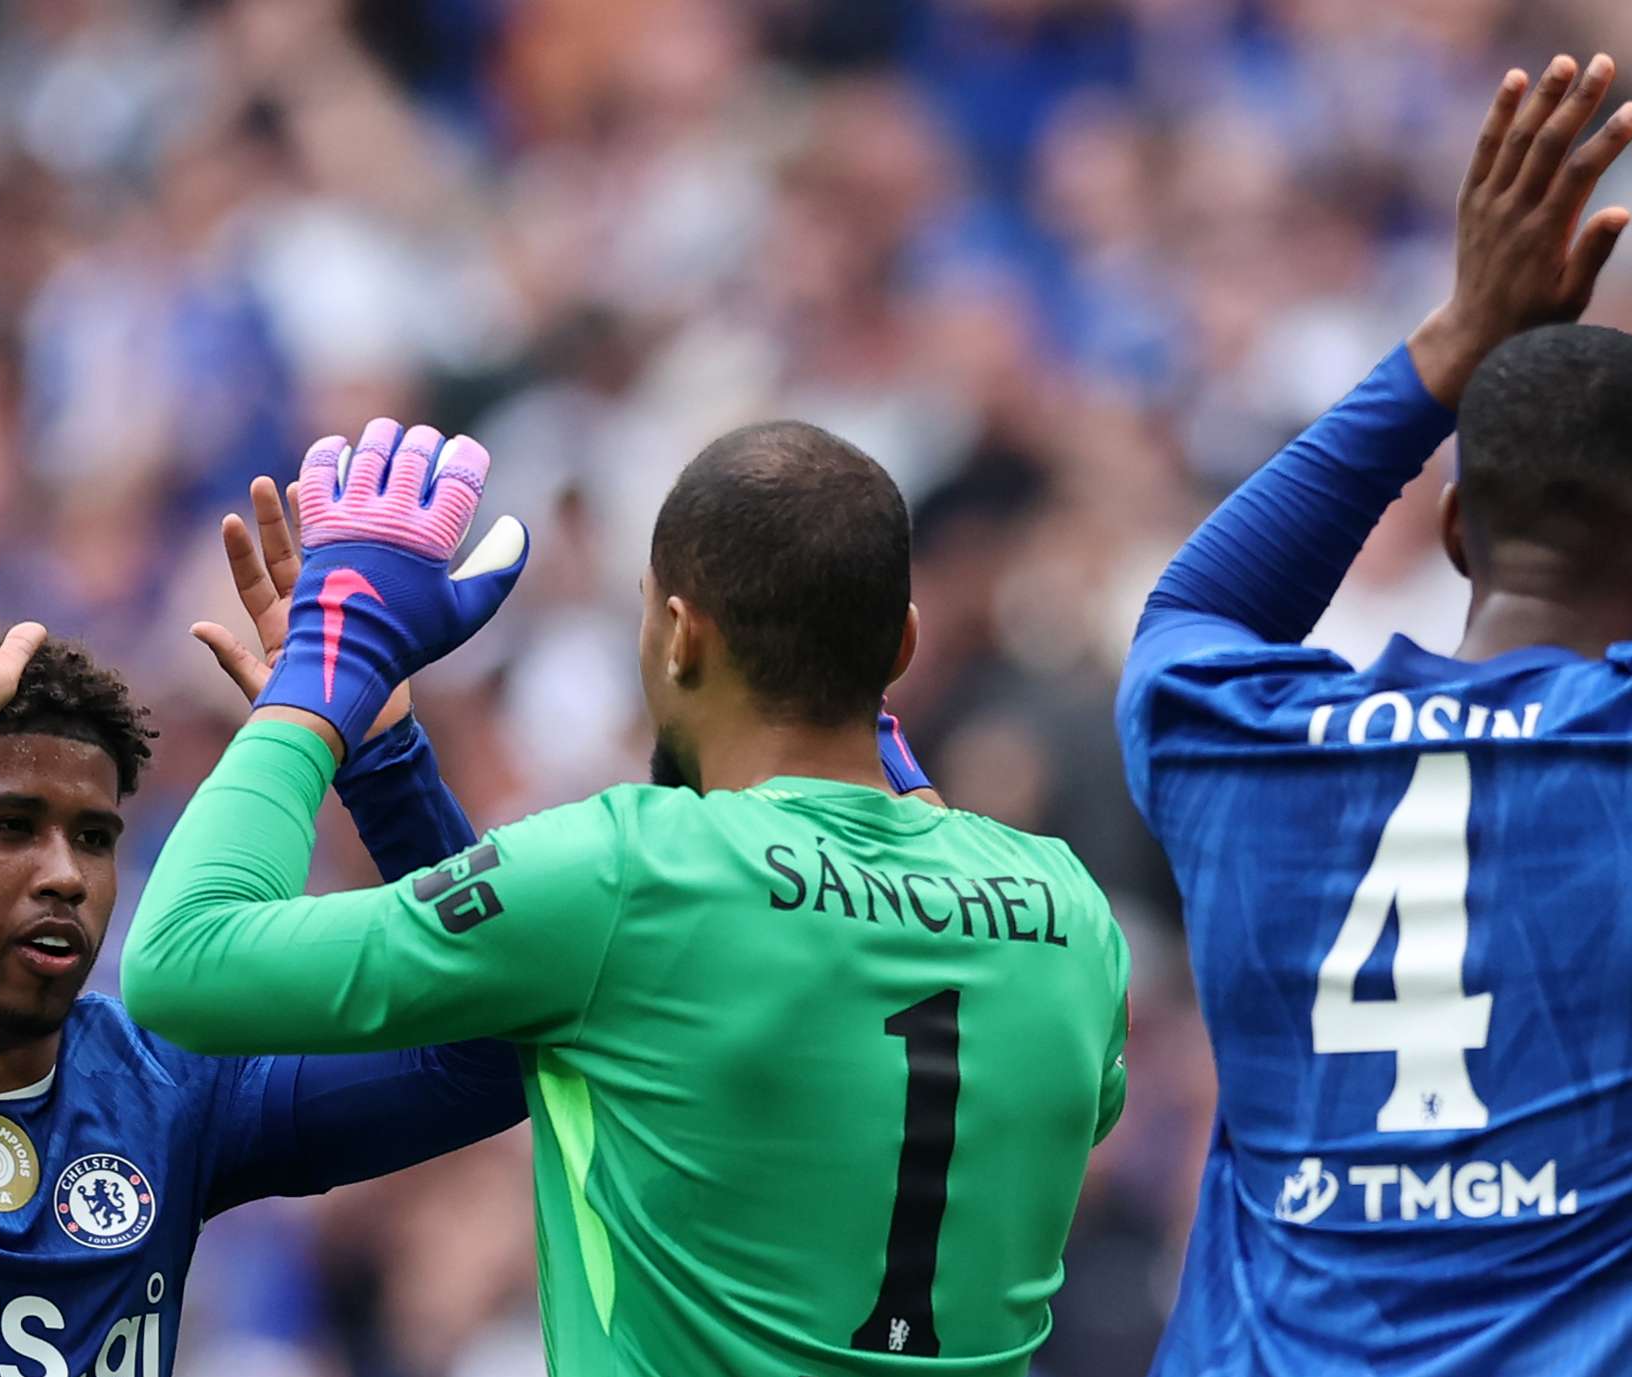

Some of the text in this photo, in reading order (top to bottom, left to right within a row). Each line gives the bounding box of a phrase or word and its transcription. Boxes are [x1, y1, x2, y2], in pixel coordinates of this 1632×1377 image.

[764, 836, 1068, 948] SÁNCHEZ
[1311, 751, 1493, 1133] 4
[60, 1157, 120, 1191] CHELSEA
[849, 988, 963, 1359] 1
[87, 1214, 149, 1246] FOOTBALL CLUB
